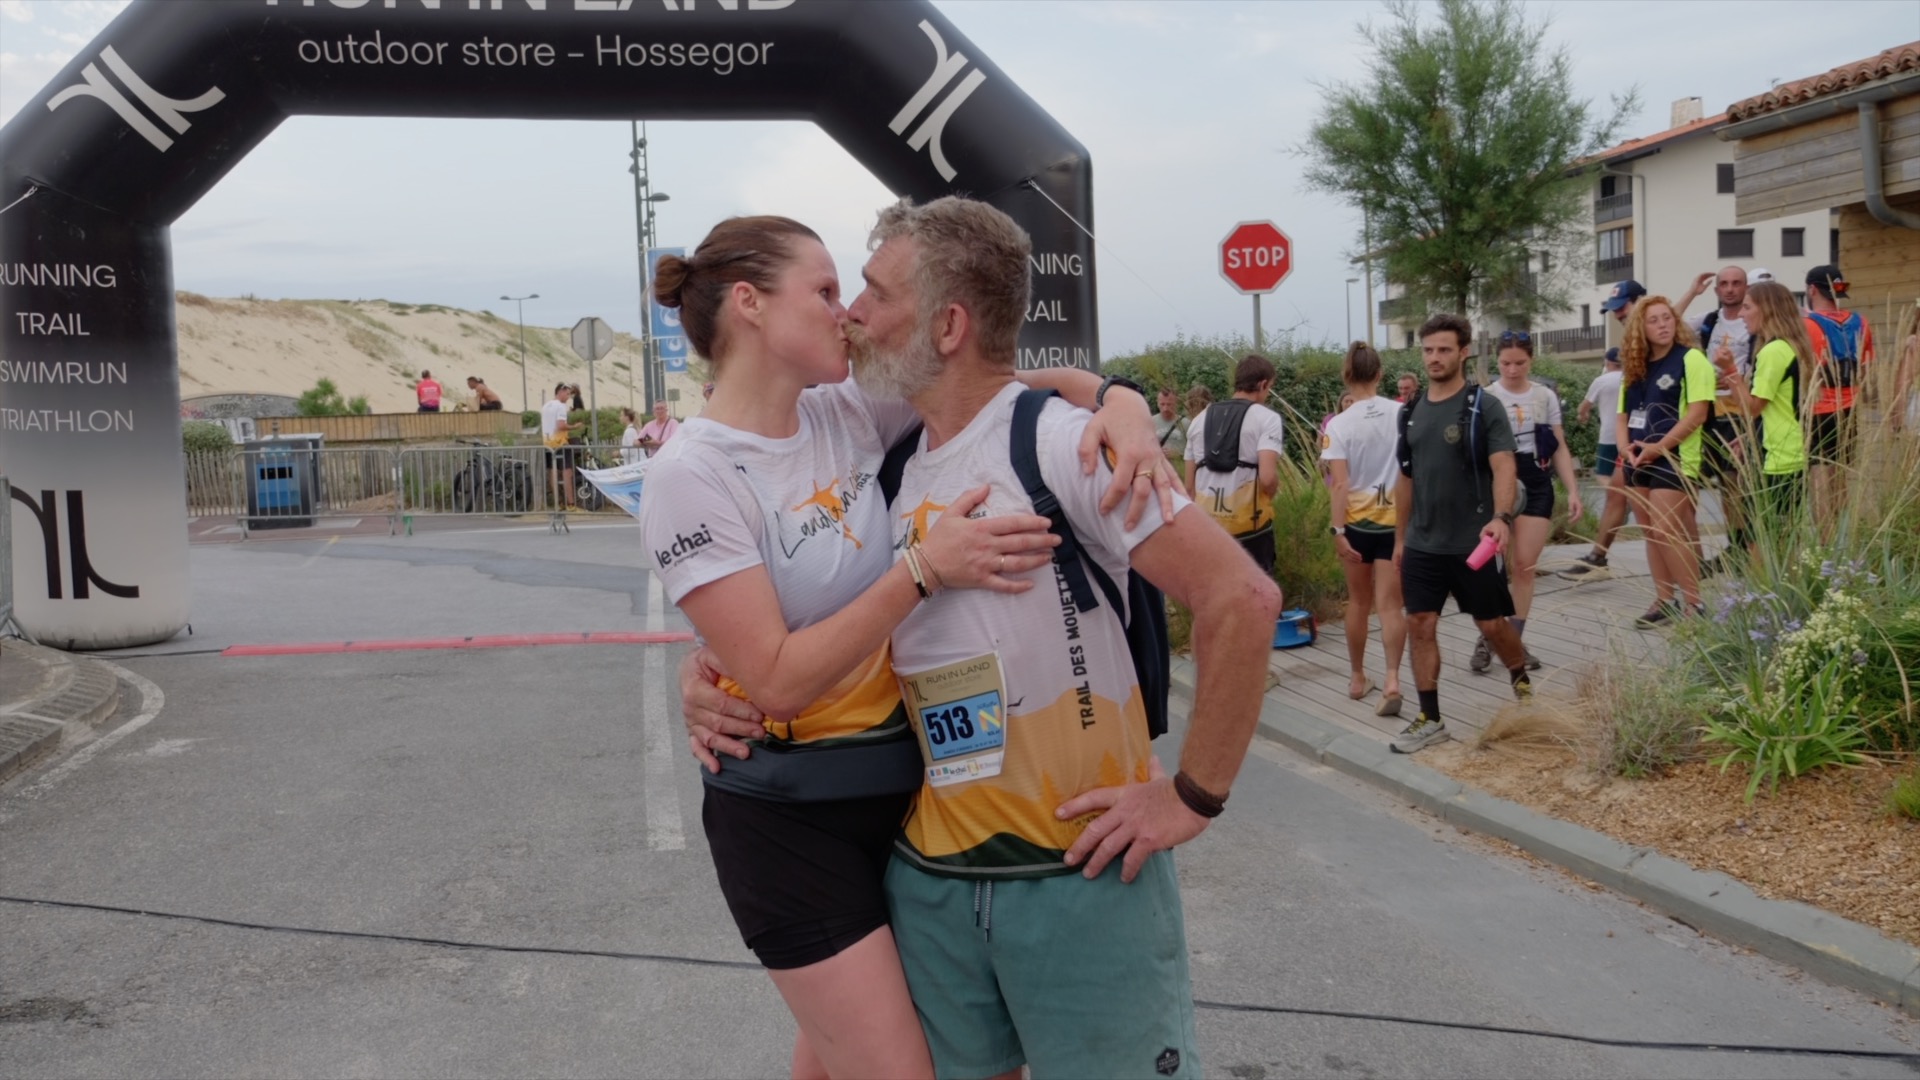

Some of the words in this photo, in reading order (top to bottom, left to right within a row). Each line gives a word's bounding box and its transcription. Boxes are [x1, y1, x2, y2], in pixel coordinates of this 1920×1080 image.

[298, 29, 449, 65] outdoor
[462, 36, 556, 66] store
[596, 35, 775, 76] Hossegor
[1028, 252, 1084, 276] NING
[1227, 246, 1285, 269] STOP
[1024, 300, 1068, 322] RAIL
[16, 312, 91, 336] TRAIL
[1017, 346, 1091, 369] IMRUN
[0, 360, 128, 384] SWIMRUN
[1, 408, 134, 432] TRIATHLON
[1051, 556, 1081, 640] MOUETT
[925, 672, 947, 685] RUN
[947, 670, 959, 680] IN
[960, 661, 991, 676] LAND
[1069, 645, 1088, 677] DES
[1076, 680, 1096, 730] TRAIL
[925, 705, 975, 745] 513
